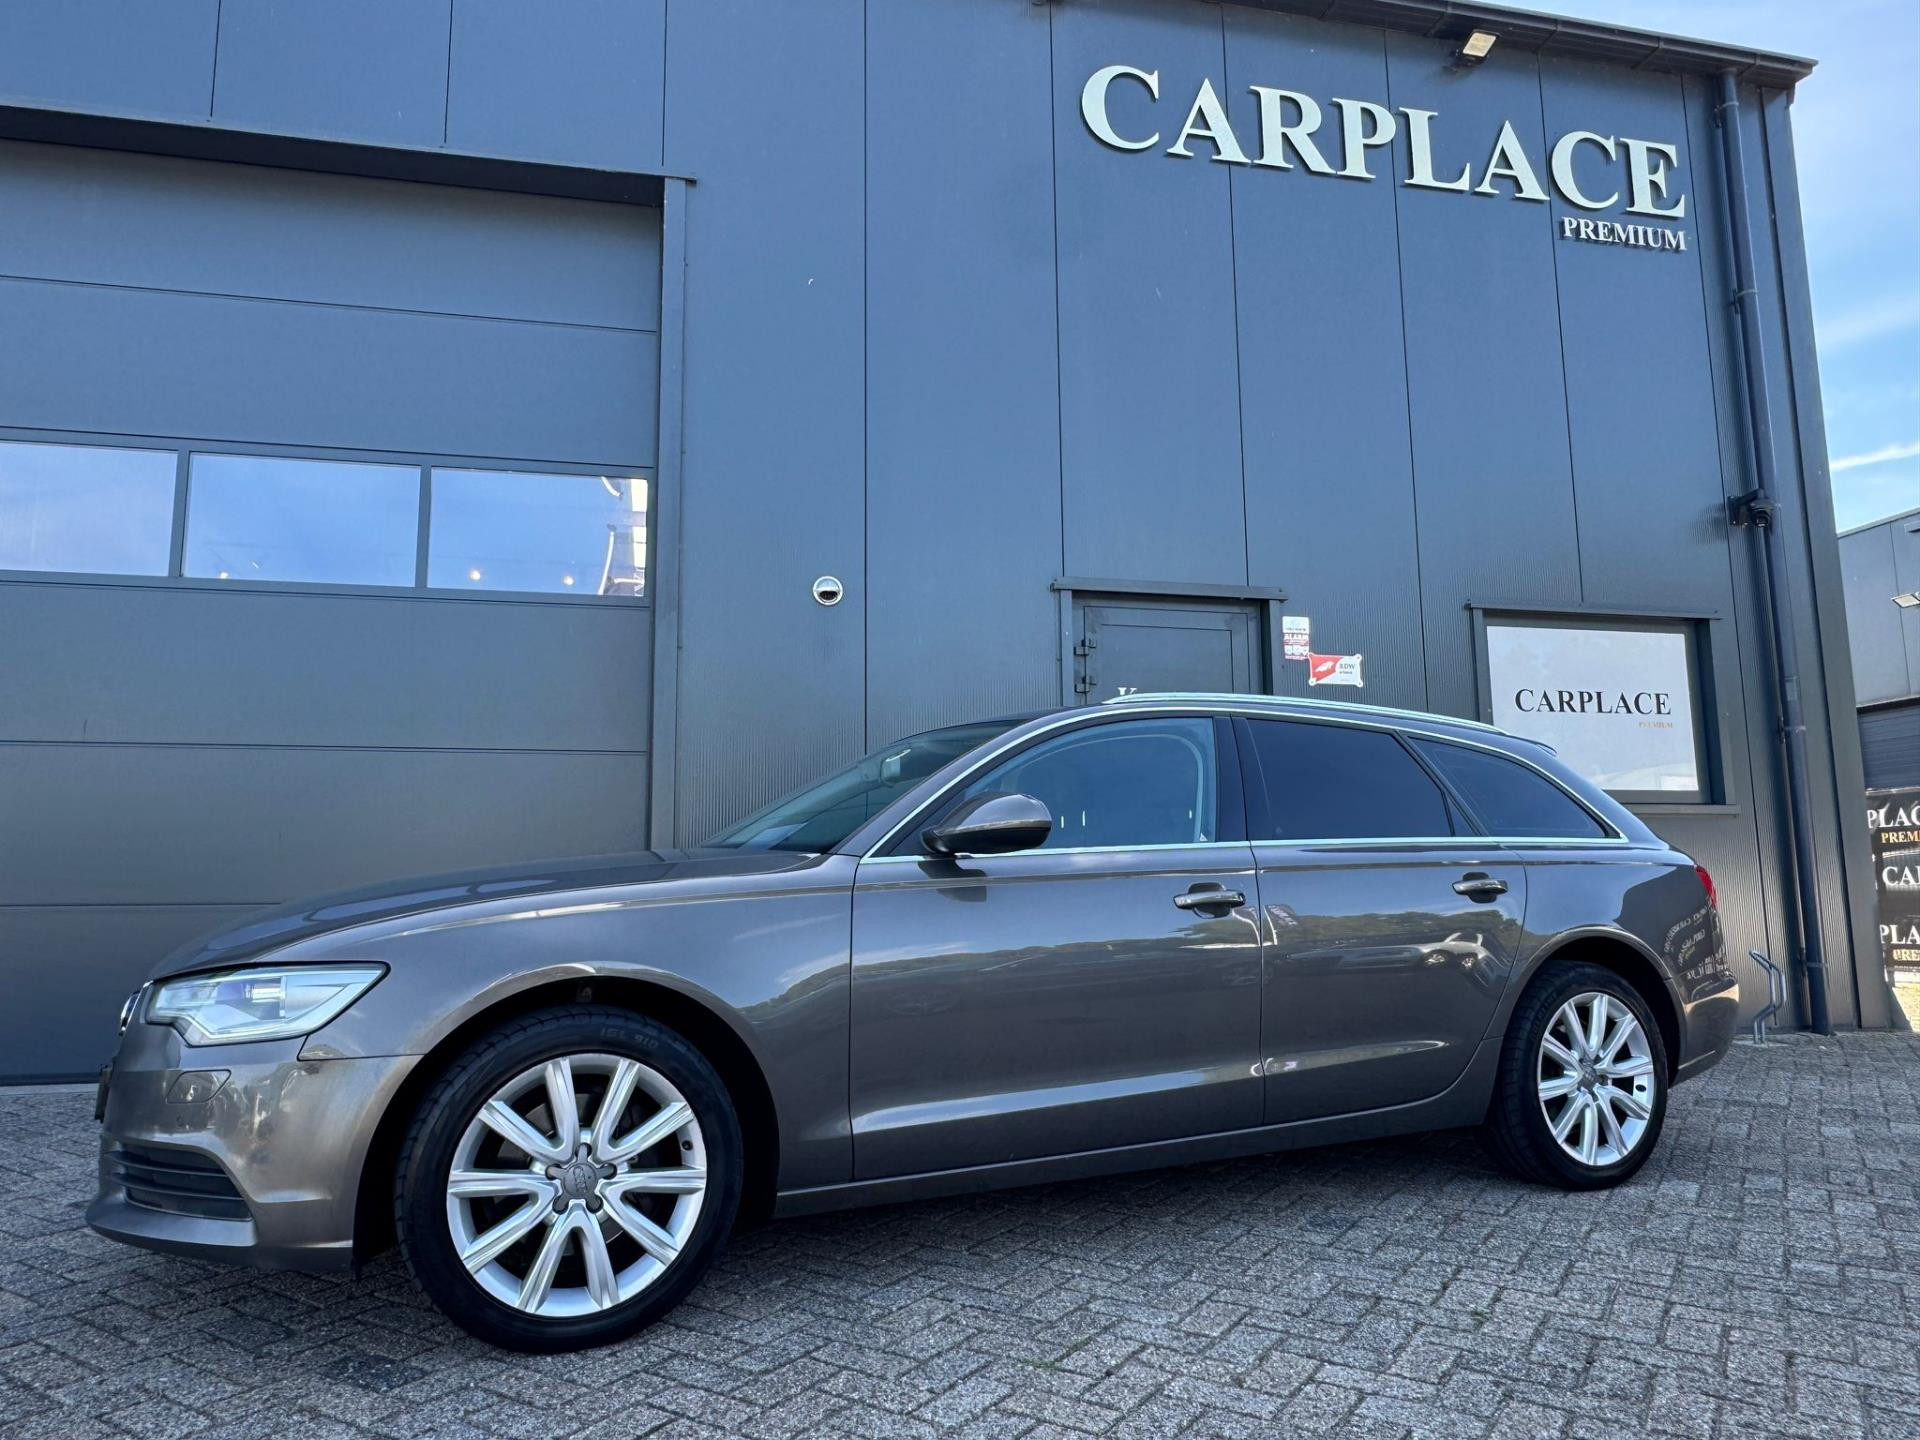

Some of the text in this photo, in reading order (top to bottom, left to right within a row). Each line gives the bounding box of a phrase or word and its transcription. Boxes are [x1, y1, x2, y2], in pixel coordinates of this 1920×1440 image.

[1081, 64, 1687, 218] CARPLACE
[1561, 216, 1687, 250] PREMIUM
[1515, 688, 1672, 715] CARPLACE
[1881, 830, 1920, 844] PREM
